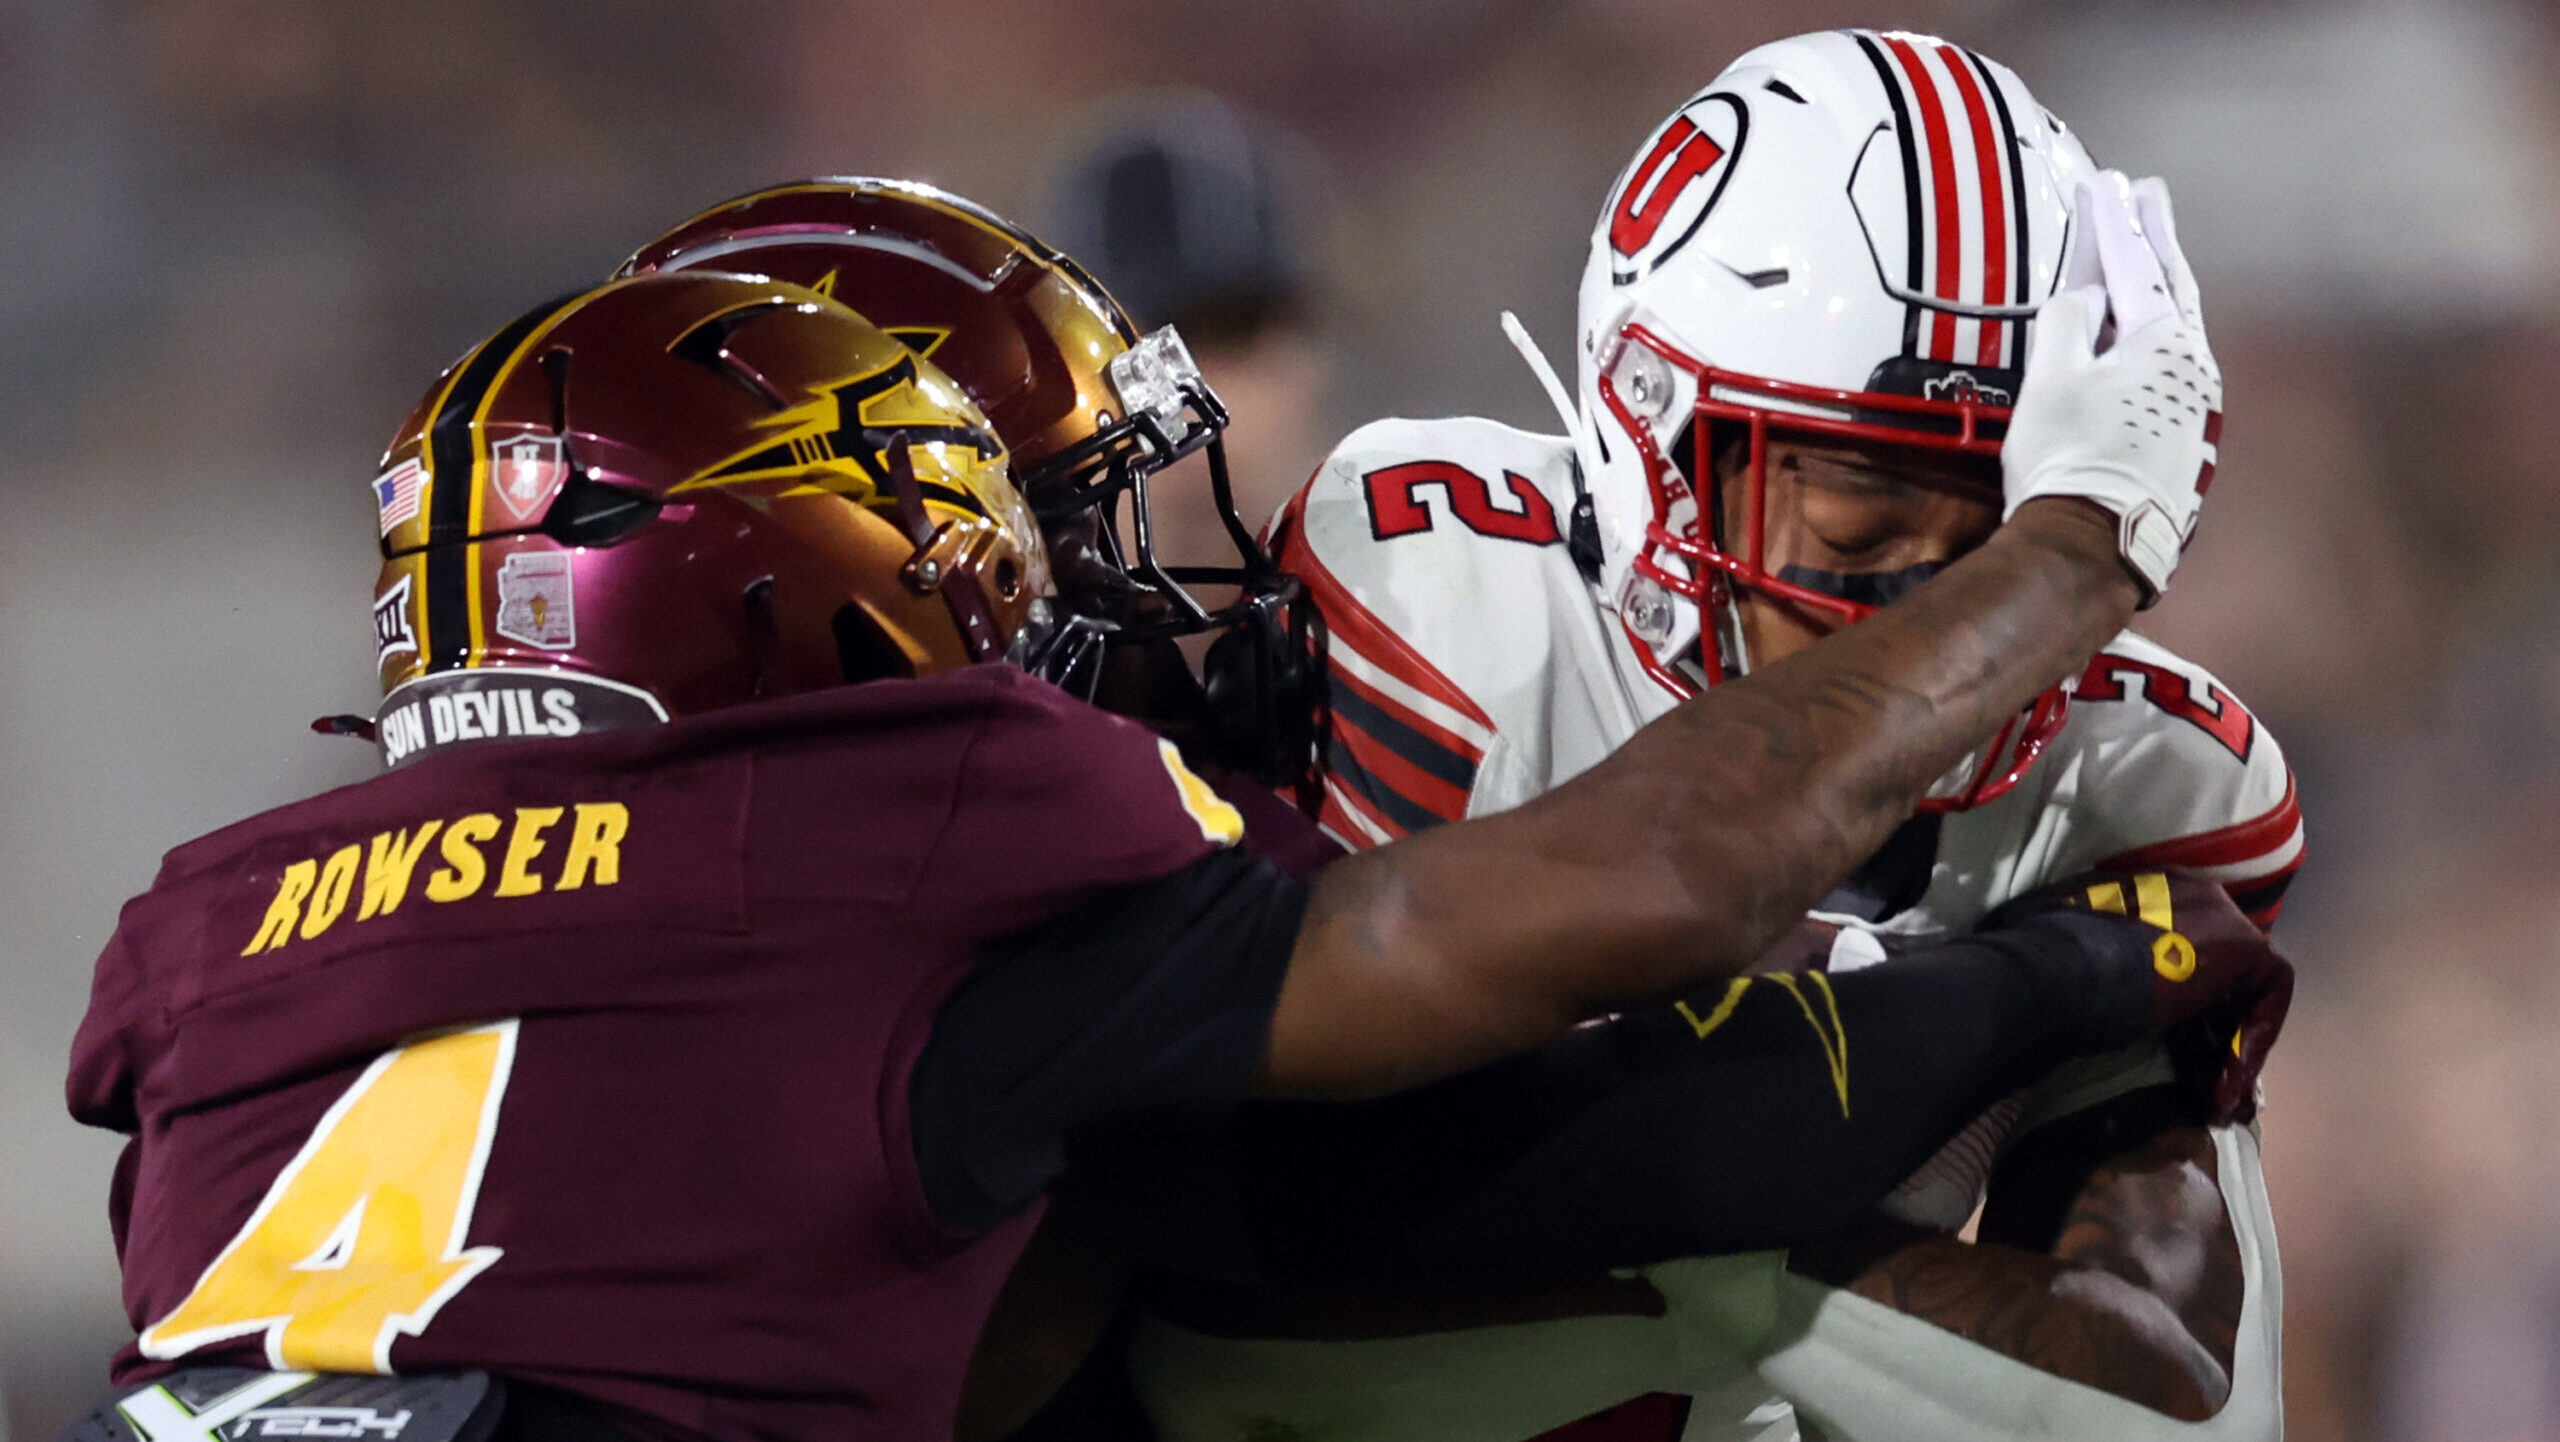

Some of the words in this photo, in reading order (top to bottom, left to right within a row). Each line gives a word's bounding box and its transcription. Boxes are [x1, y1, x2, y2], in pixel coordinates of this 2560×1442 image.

[1610, 113, 1726, 260] U
[1363, 460, 1567, 547] 2
[382, 702, 427, 767] SUN
[429, 688, 581, 745] DEVILS
[2069, 651, 2255, 765] 2
[240, 801, 630, 957] ROWSER
[139, 1016, 521, 1375] 4
